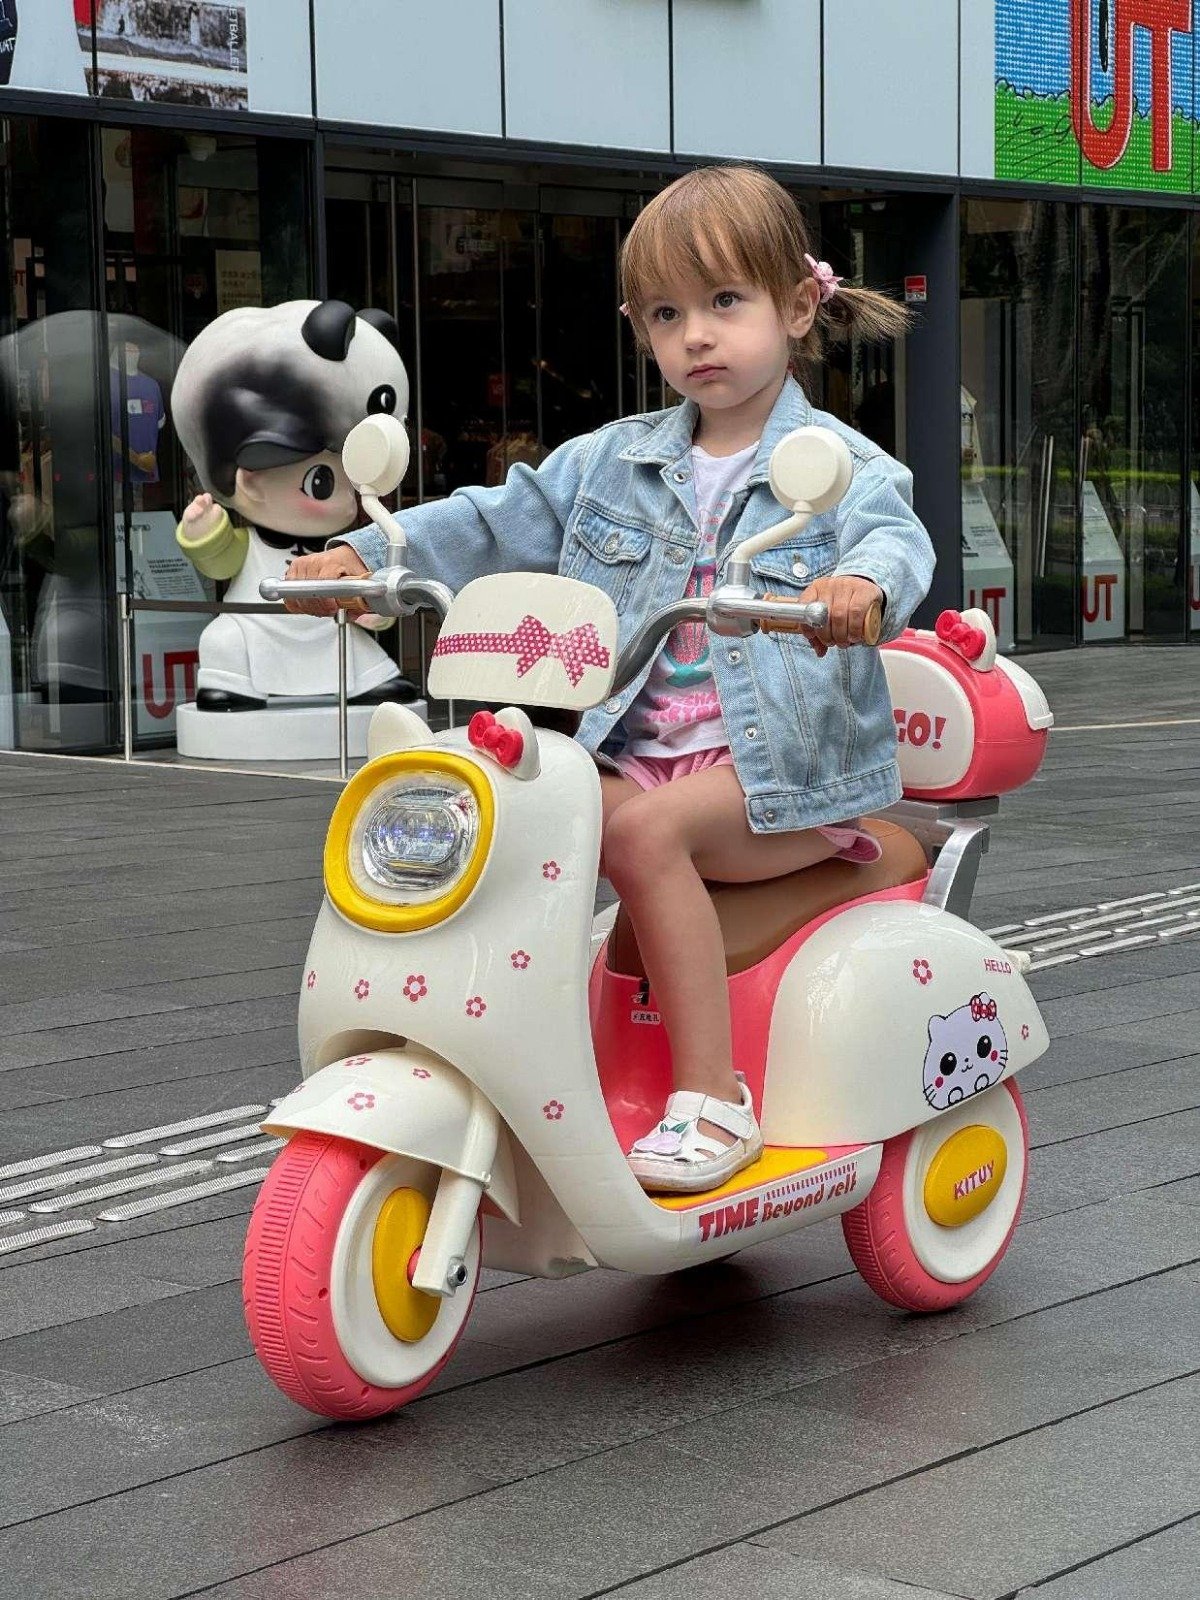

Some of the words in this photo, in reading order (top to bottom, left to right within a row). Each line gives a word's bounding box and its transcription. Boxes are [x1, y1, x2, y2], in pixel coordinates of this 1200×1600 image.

[1070, 0, 1193, 172] UT
[1081, 574, 1118, 623] UT
[142, 651, 200, 719] UT
[983, 958, 1012, 974] HELLO
[699, 1197, 761, 1243] TIME
[761, 1182, 825, 1223] Beyond
